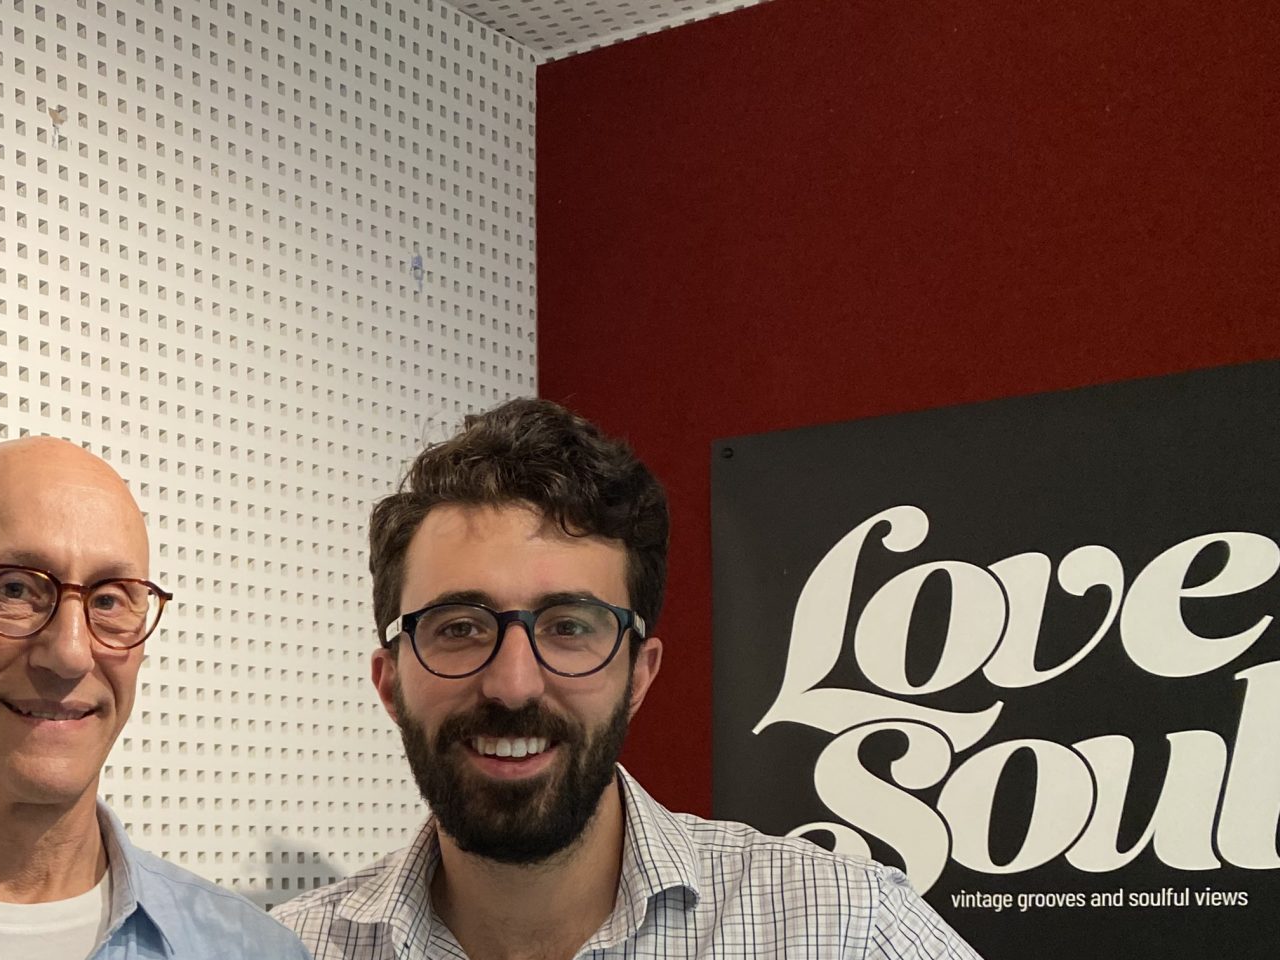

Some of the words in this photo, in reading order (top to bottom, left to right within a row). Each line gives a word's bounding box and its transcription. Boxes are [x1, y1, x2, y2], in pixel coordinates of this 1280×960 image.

[751, 504, 1280, 753] Love
[783, 660, 1280, 898] Soul
[950, 888, 1014, 913] vintage
[1017, 892, 1087, 913] grooves
[1090, 887, 1124, 908] and
[1128, 887, 1190, 908] soulful
[1194, 886, 1249, 907] views
